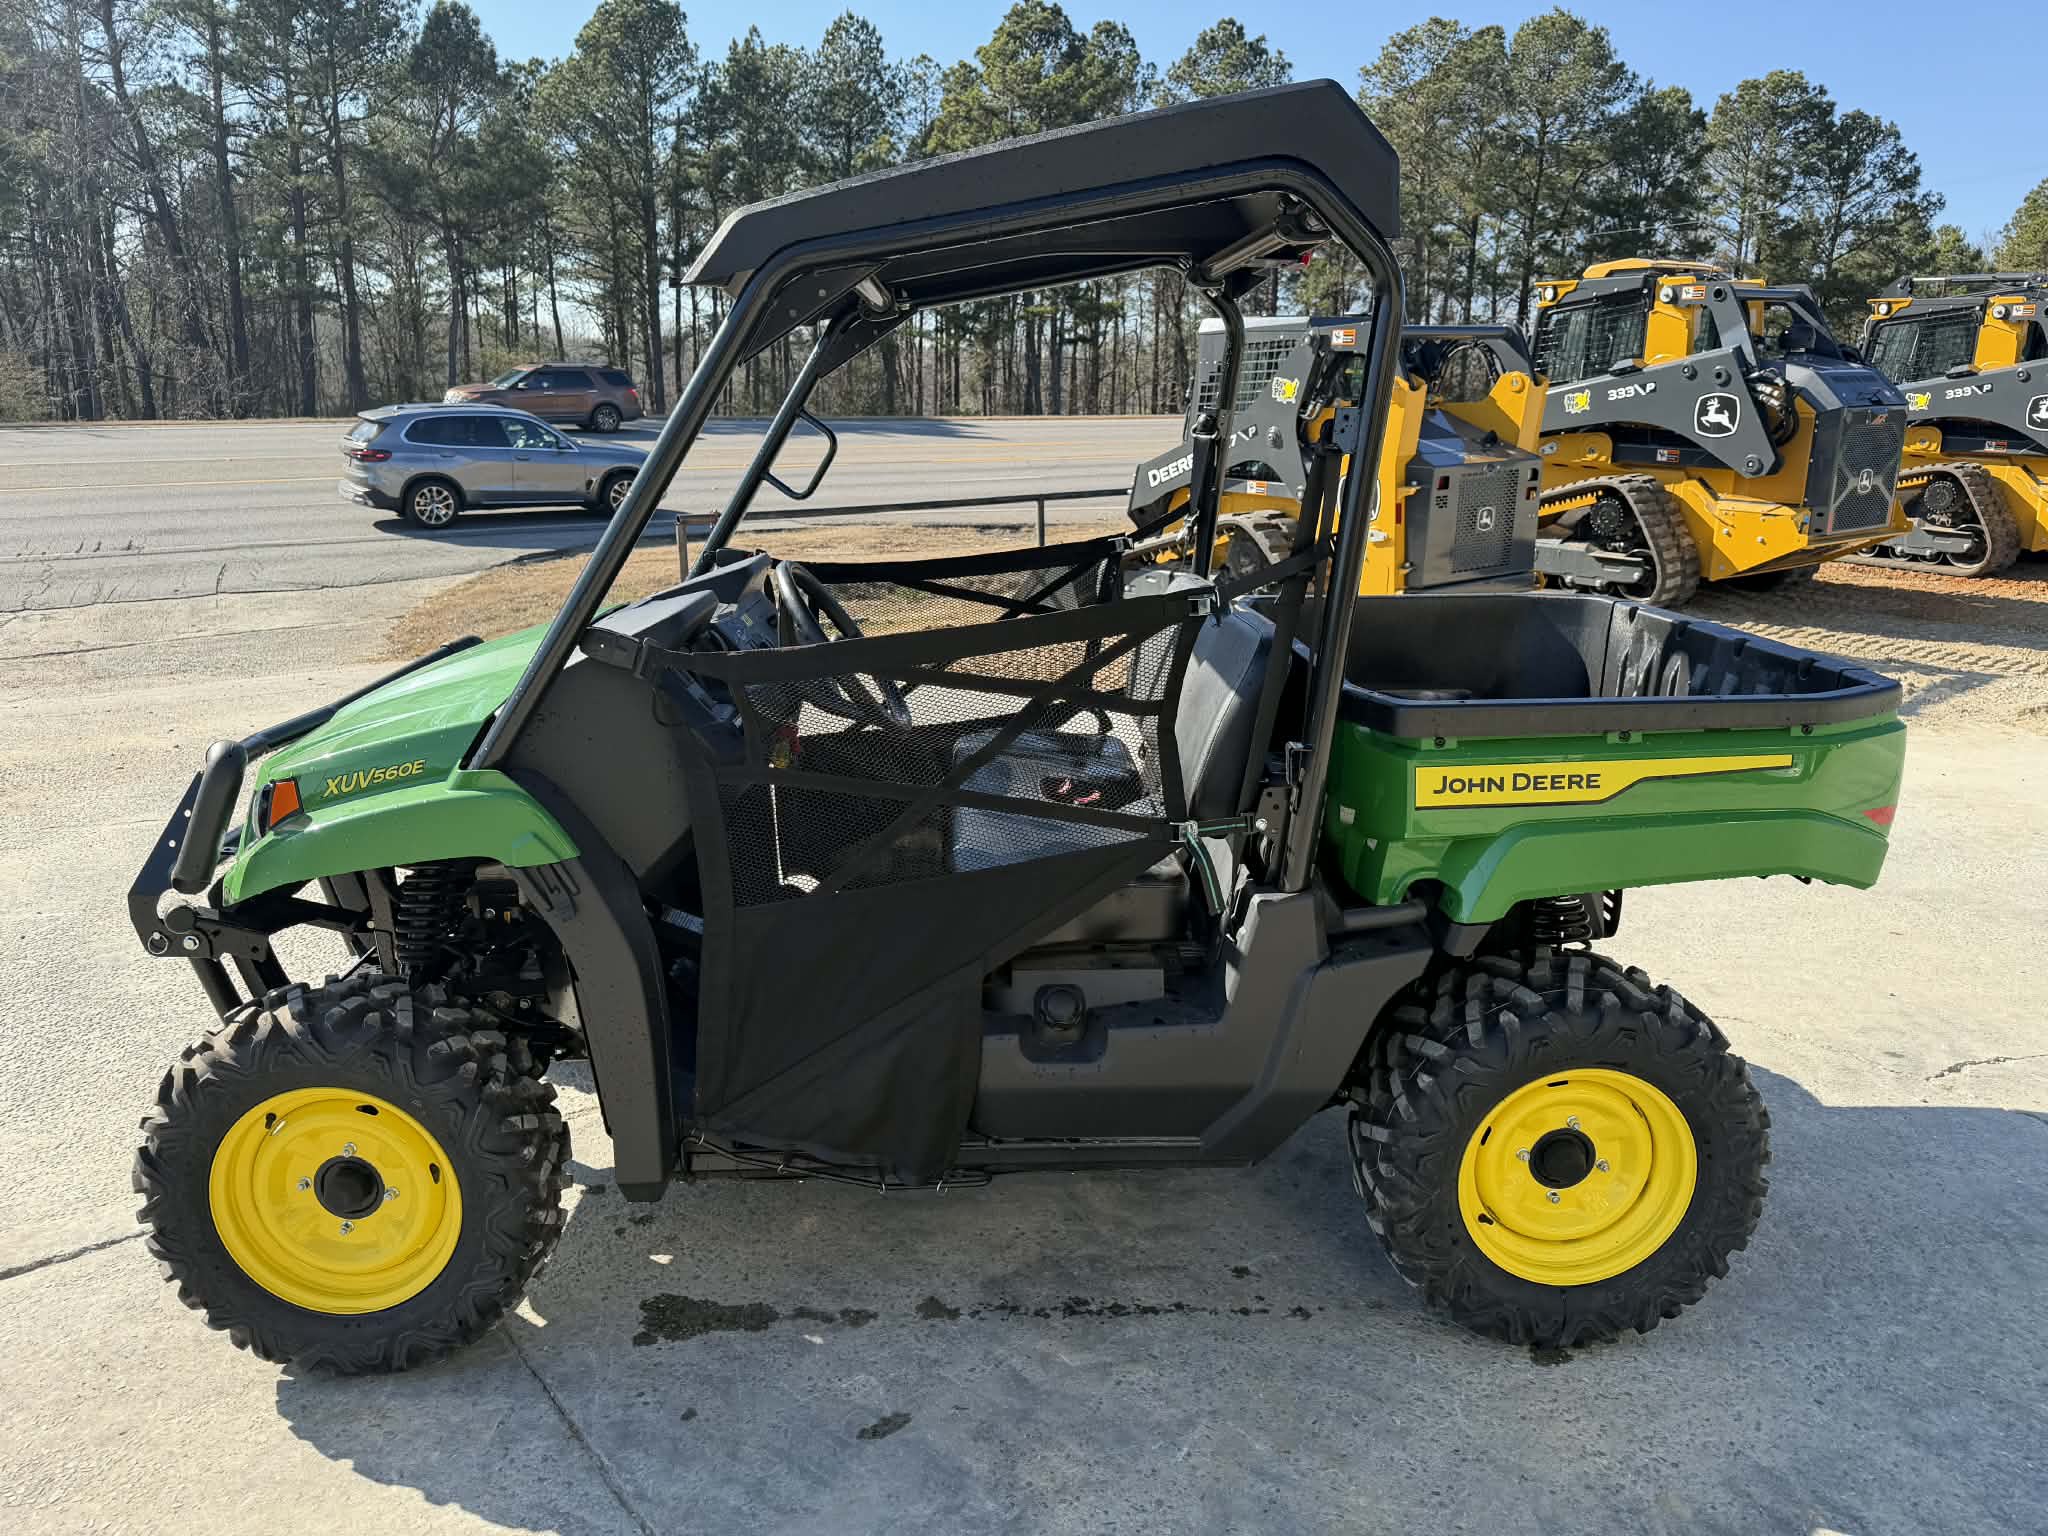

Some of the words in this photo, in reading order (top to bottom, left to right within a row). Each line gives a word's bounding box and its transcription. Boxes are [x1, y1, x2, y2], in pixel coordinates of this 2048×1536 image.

[323, 759, 425, 798] XUV560E
[1433, 775, 1505, 794] JOHN
[1512, 773, 1601, 791] DEERE
